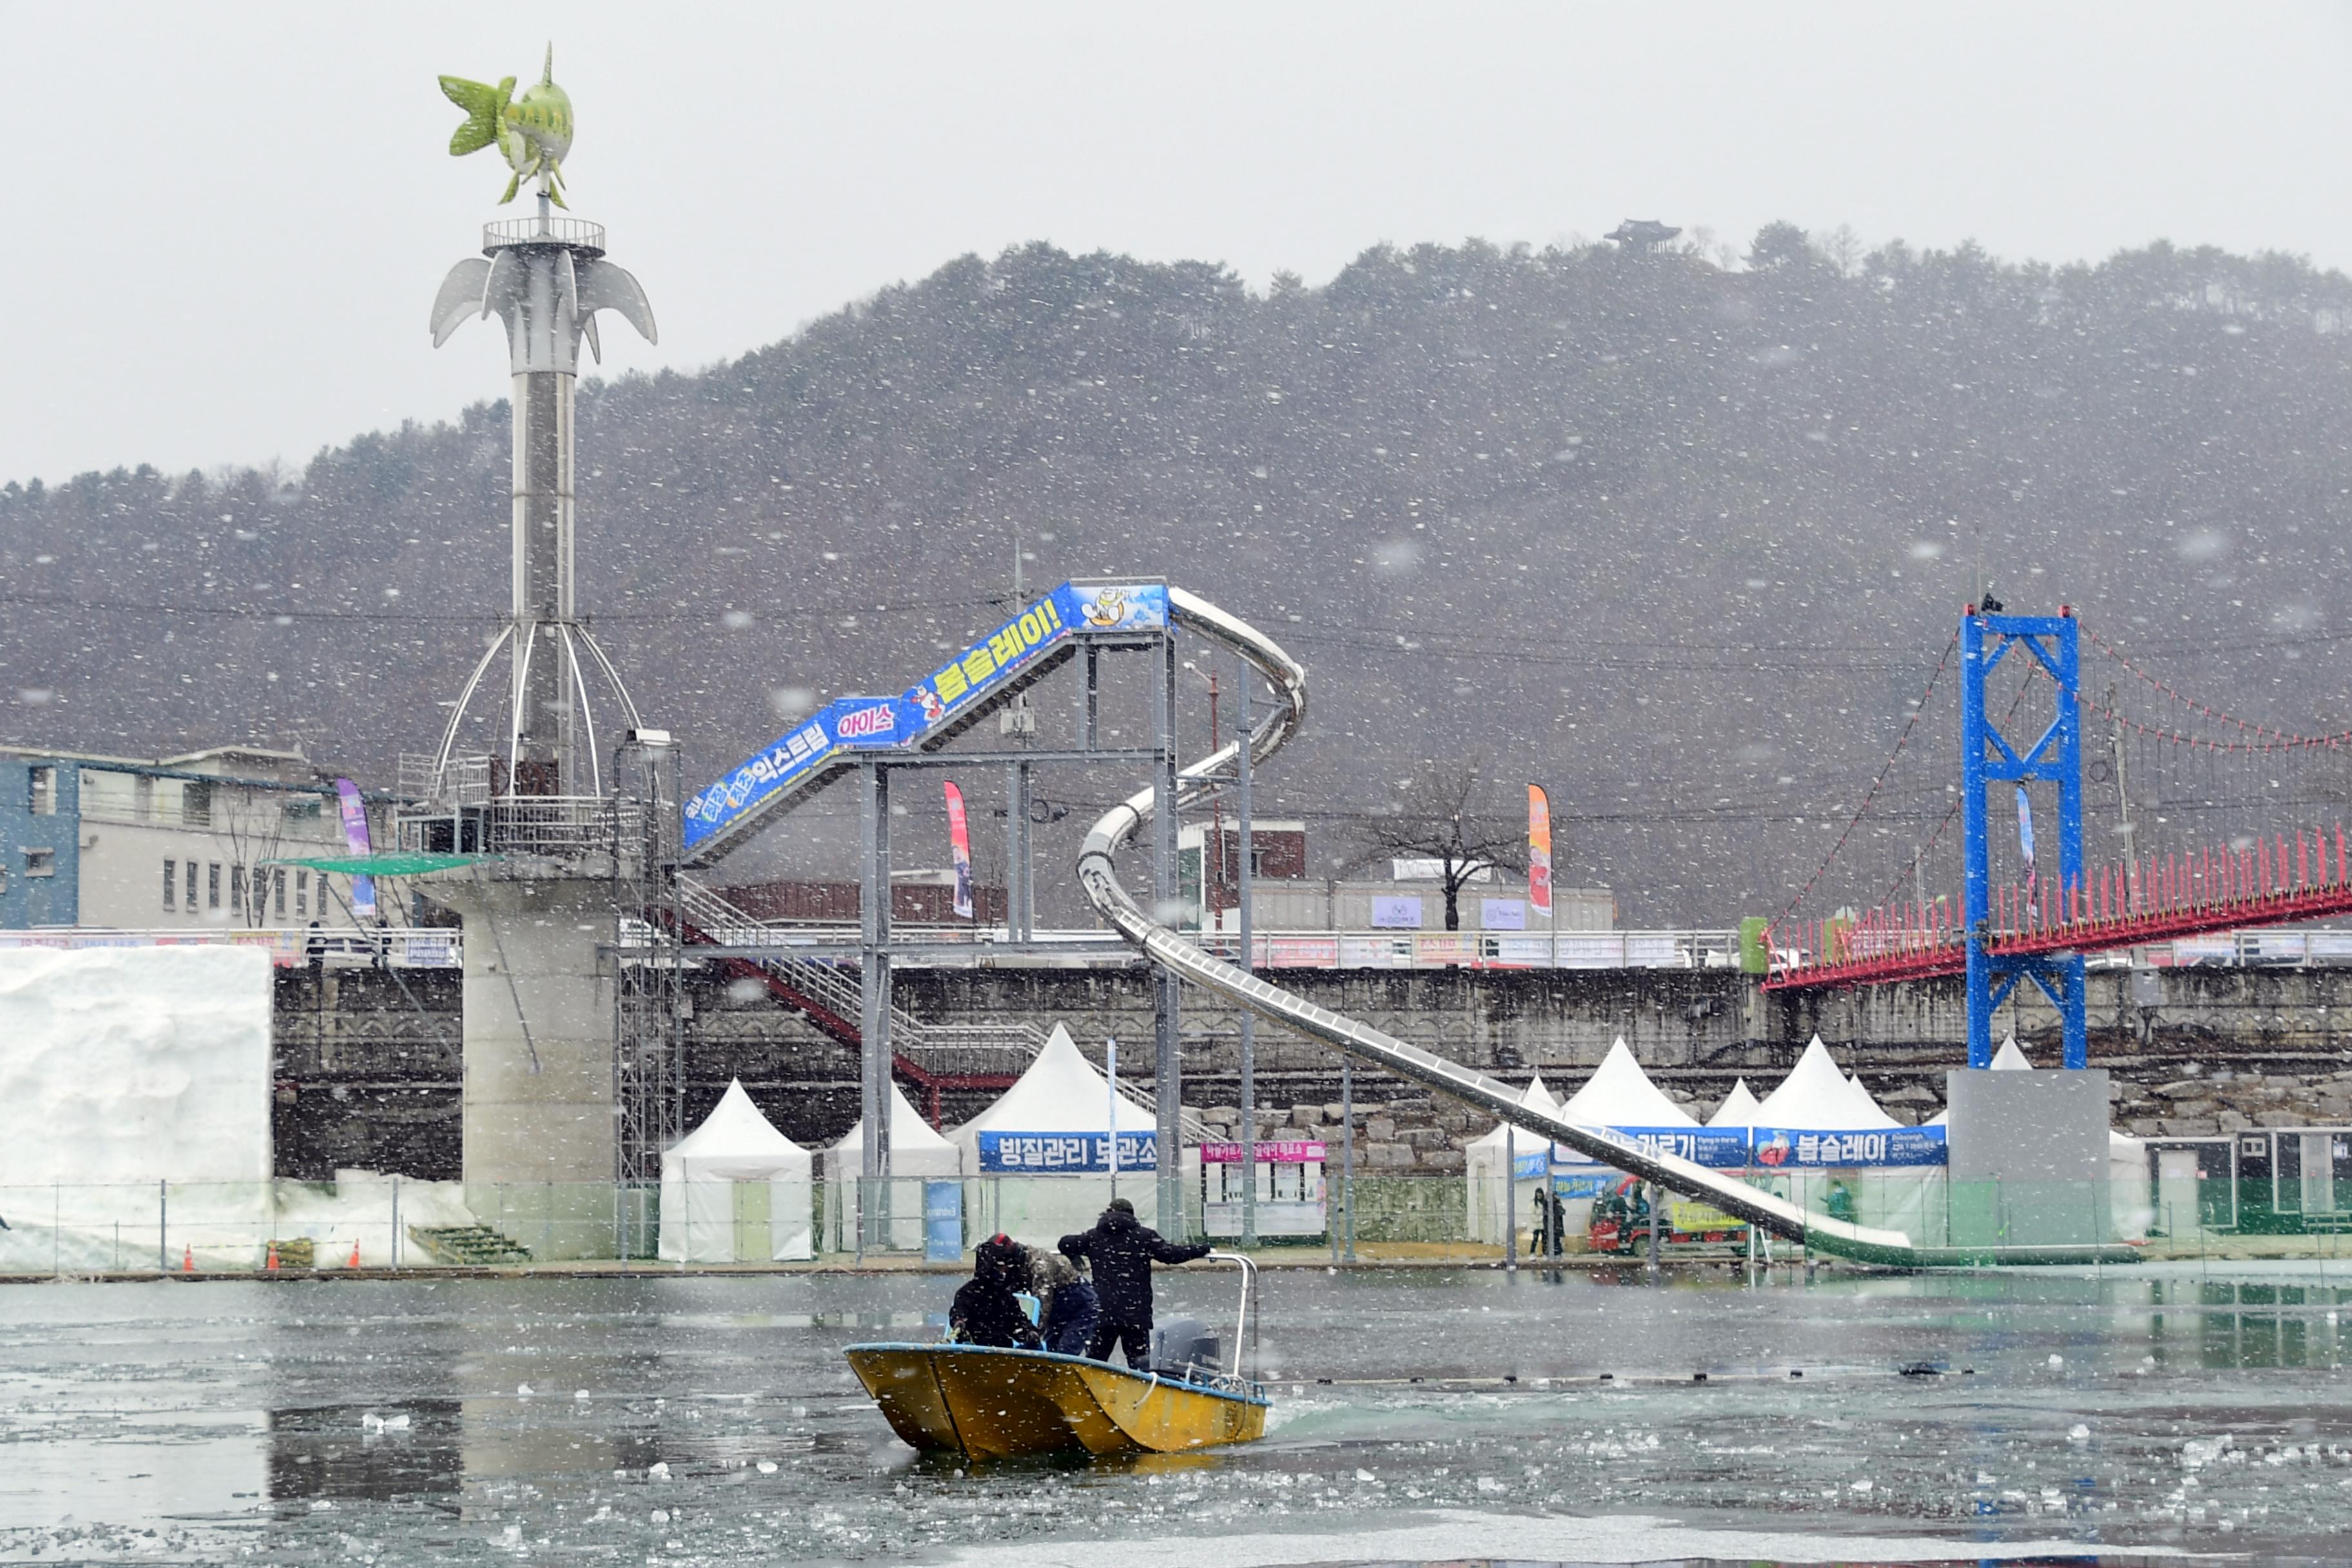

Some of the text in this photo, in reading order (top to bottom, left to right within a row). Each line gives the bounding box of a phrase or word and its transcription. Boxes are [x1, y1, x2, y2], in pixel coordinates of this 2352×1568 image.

[934, 598, 1062, 704] 봅슬레이!
[838, 703, 894, 737] 아이스
[752, 721, 829, 783] 익스트림
[999, 1137, 1157, 1166] 빙질관리 보관소
[1796, 1135, 1887, 1161] 봅슬레이
